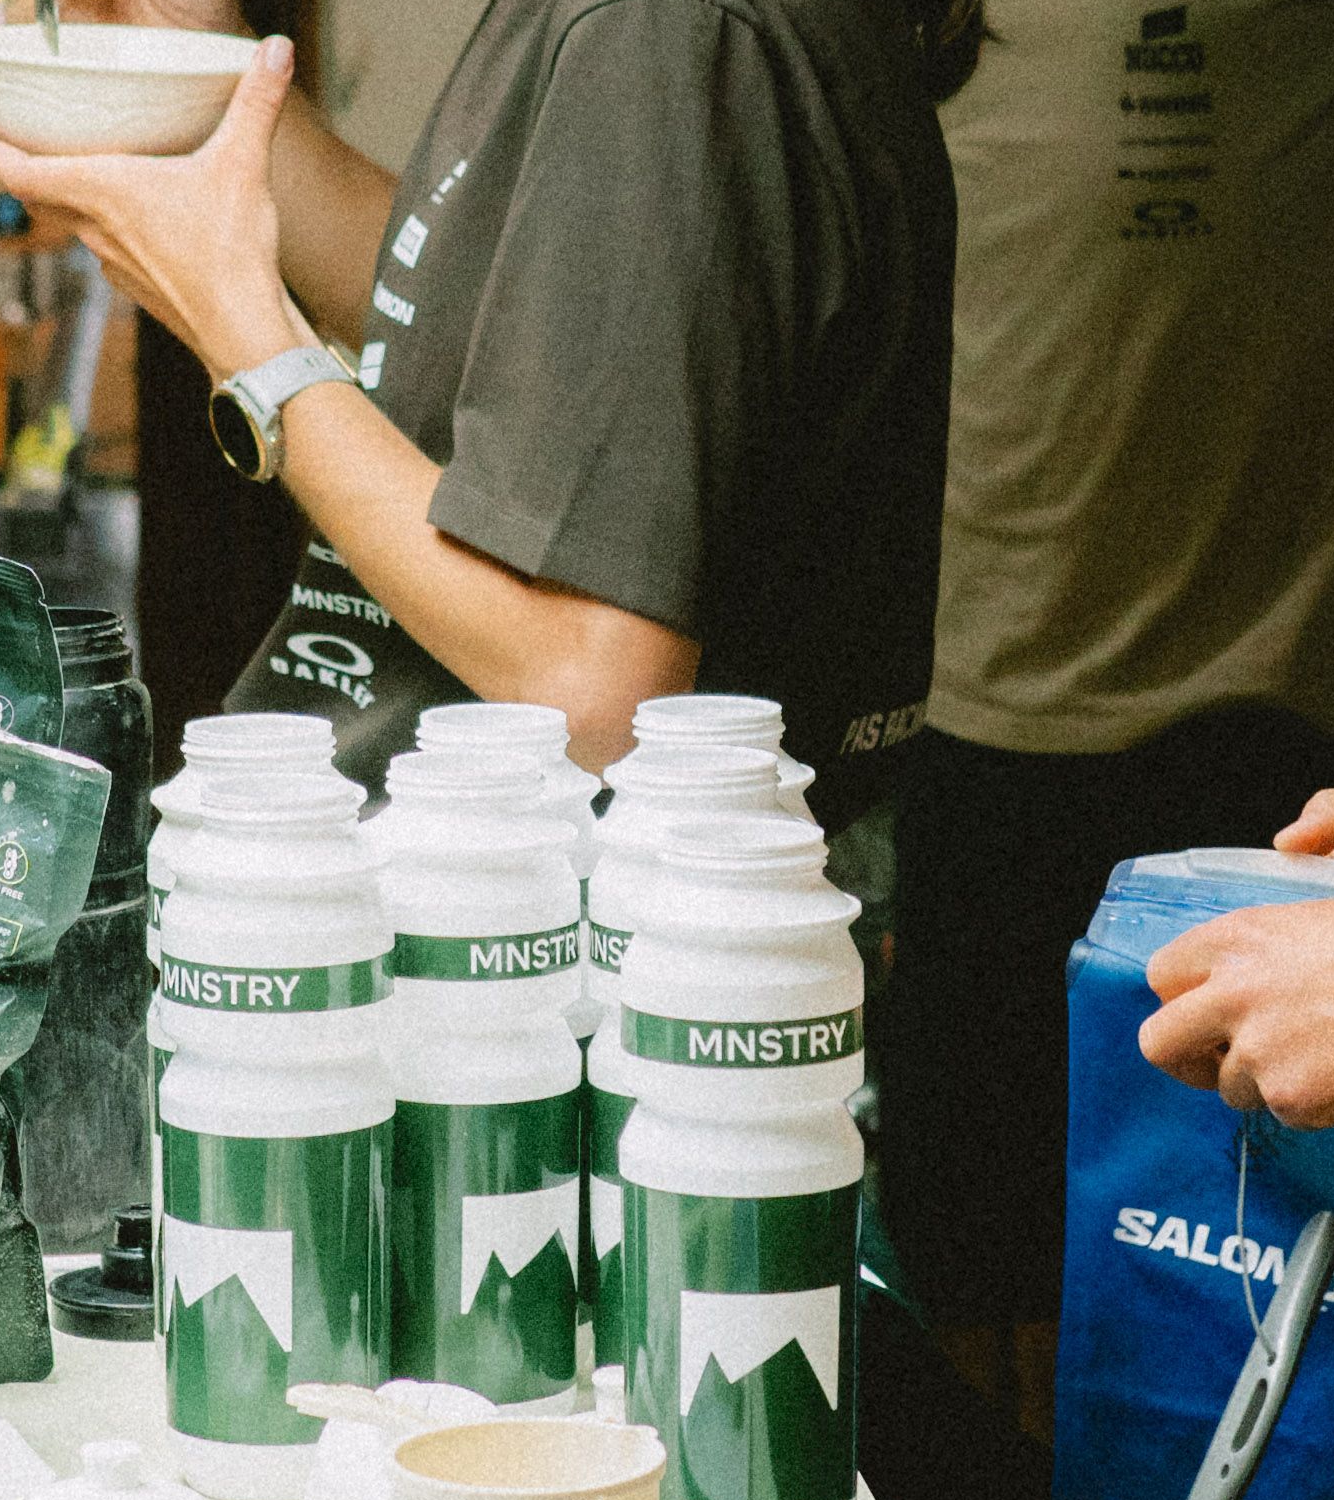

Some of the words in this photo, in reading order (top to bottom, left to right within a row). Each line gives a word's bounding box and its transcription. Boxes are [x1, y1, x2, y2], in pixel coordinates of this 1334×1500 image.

[292, 582, 392, 628] MNSTRY
[0, 885, 24, 900] FREE
[164, 962, 301, 1006] MNSTRY
[688, 1019, 848, 1062] MNSTRY
